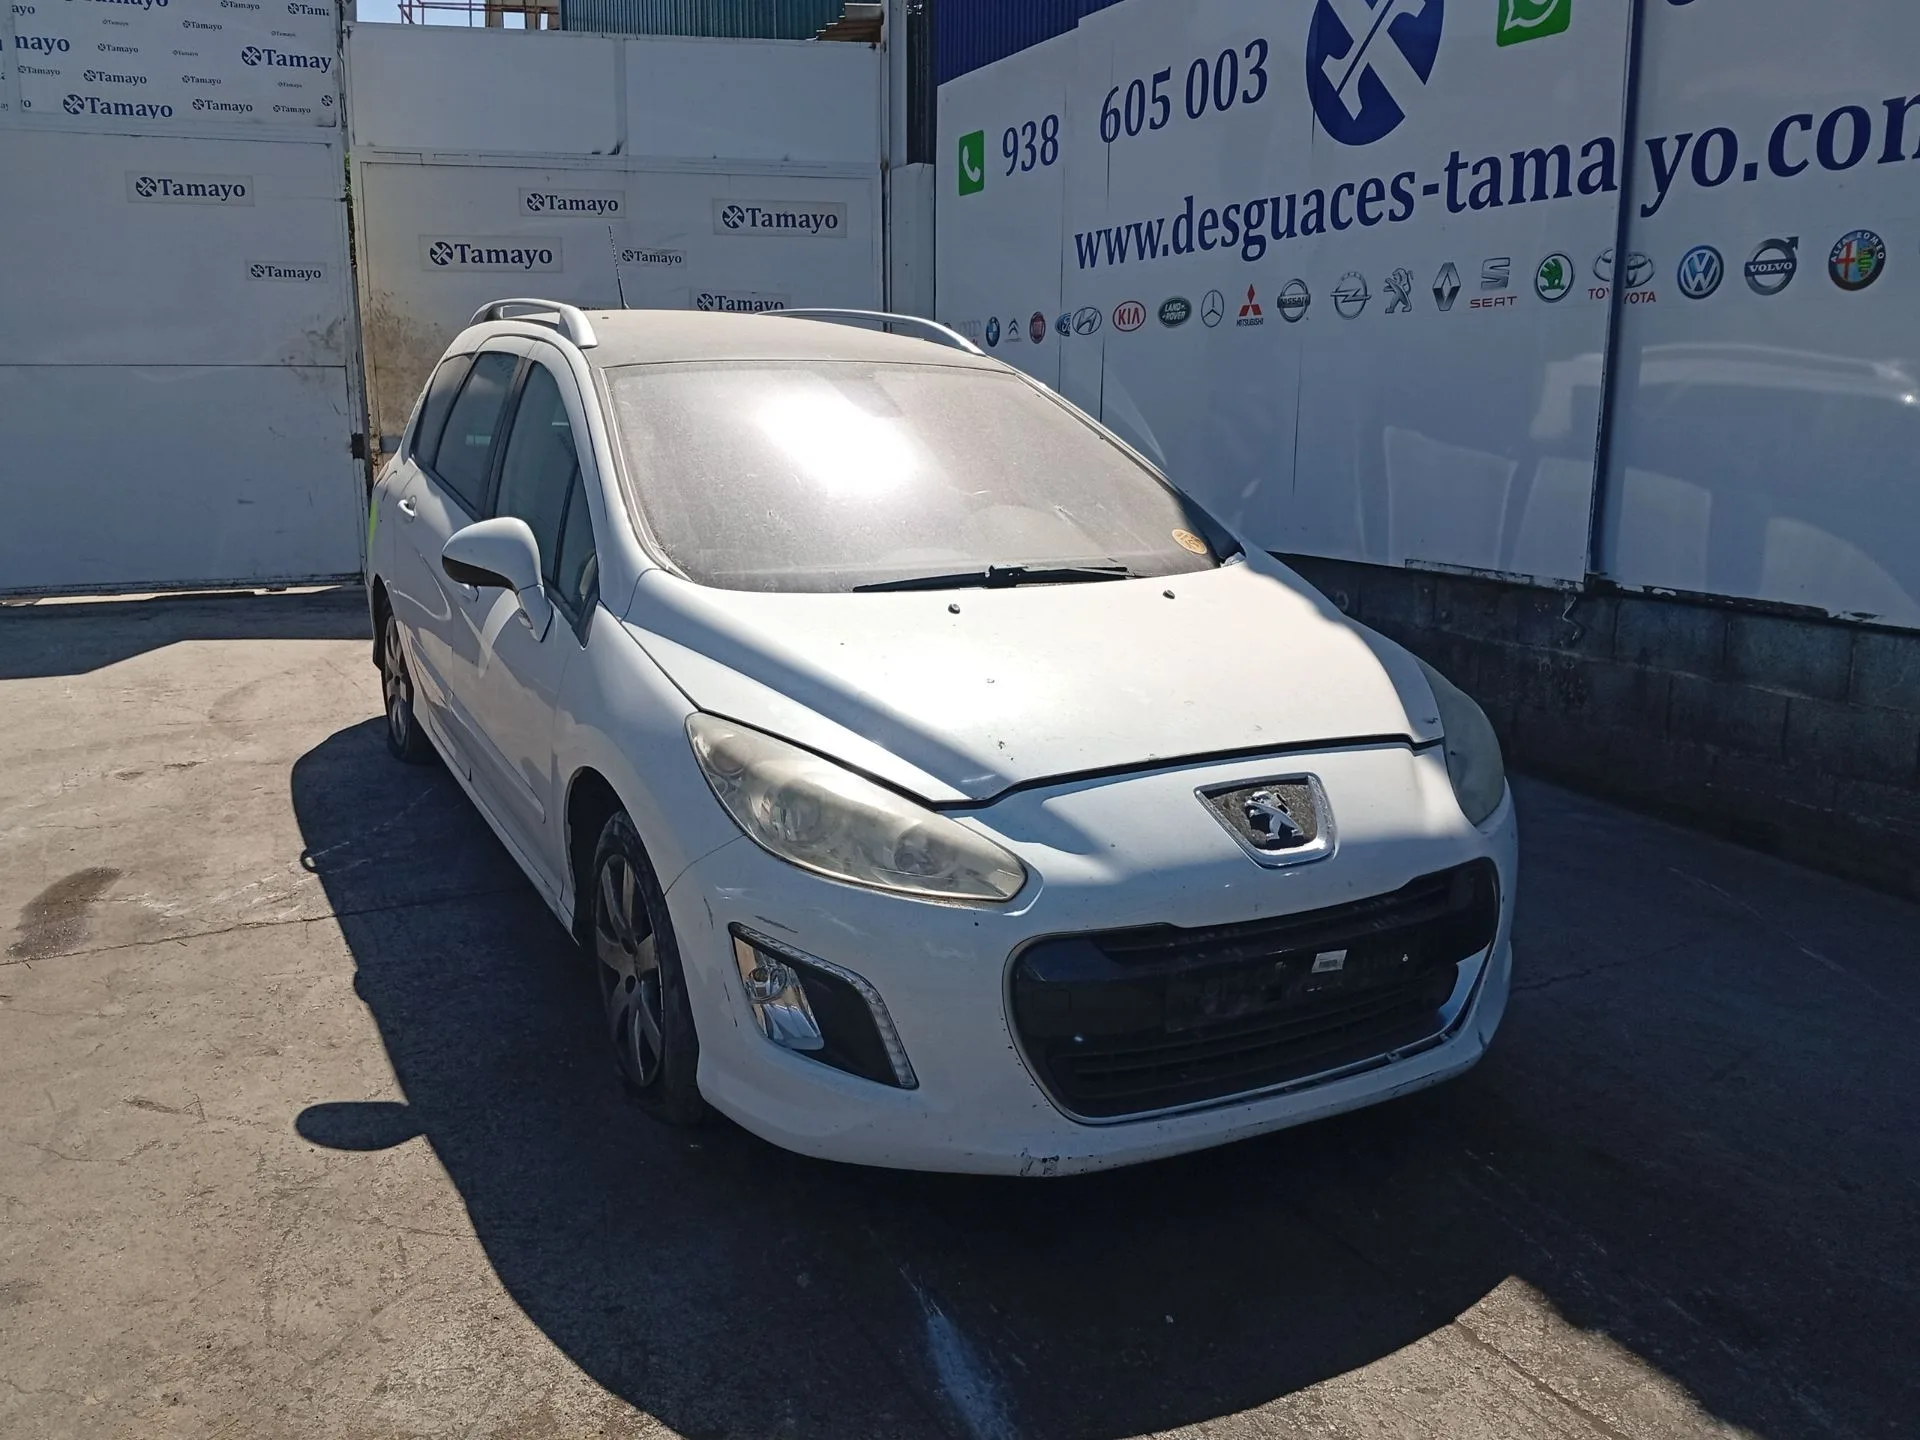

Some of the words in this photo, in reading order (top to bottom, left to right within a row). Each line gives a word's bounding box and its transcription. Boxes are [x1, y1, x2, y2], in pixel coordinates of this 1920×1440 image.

[229, 1, 260, 11] Tamayo
[190, 21, 223, 31] Tamayo
[106, 44, 139, 54] Tamayo
[26, 66, 61, 76] Tamayo
[96, 71, 147, 86] Tamayo
[189, 75, 222, 86] Tamayo
[84, 96, 173, 120] Tamayo
[204, 100, 253, 114] Tamayo
[281, 105, 311, 115] Tamayo
[1002, 113, 1060, 177] 938
[1100, 66, 1172, 144] 605
[1186, 38, 1269, 120] 003
[157, 178, 246, 201] Tamayo
[545, 194, 619, 215] Tamayo
[746, 207, 839, 233] Tamayo
[1831, 238, 1850, 263] ALFA
[1856, 231, 1885, 260] ROMEO
[454, 243, 553, 269] Tamayo
[634, 250, 682, 266] Tamayo
[265, 265, 322, 281] Tamayo
[1749, 261, 1793, 273] VOLVO
[1469, 296, 1518, 309] SEAT
[1117, 307, 1141, 326] KIA
